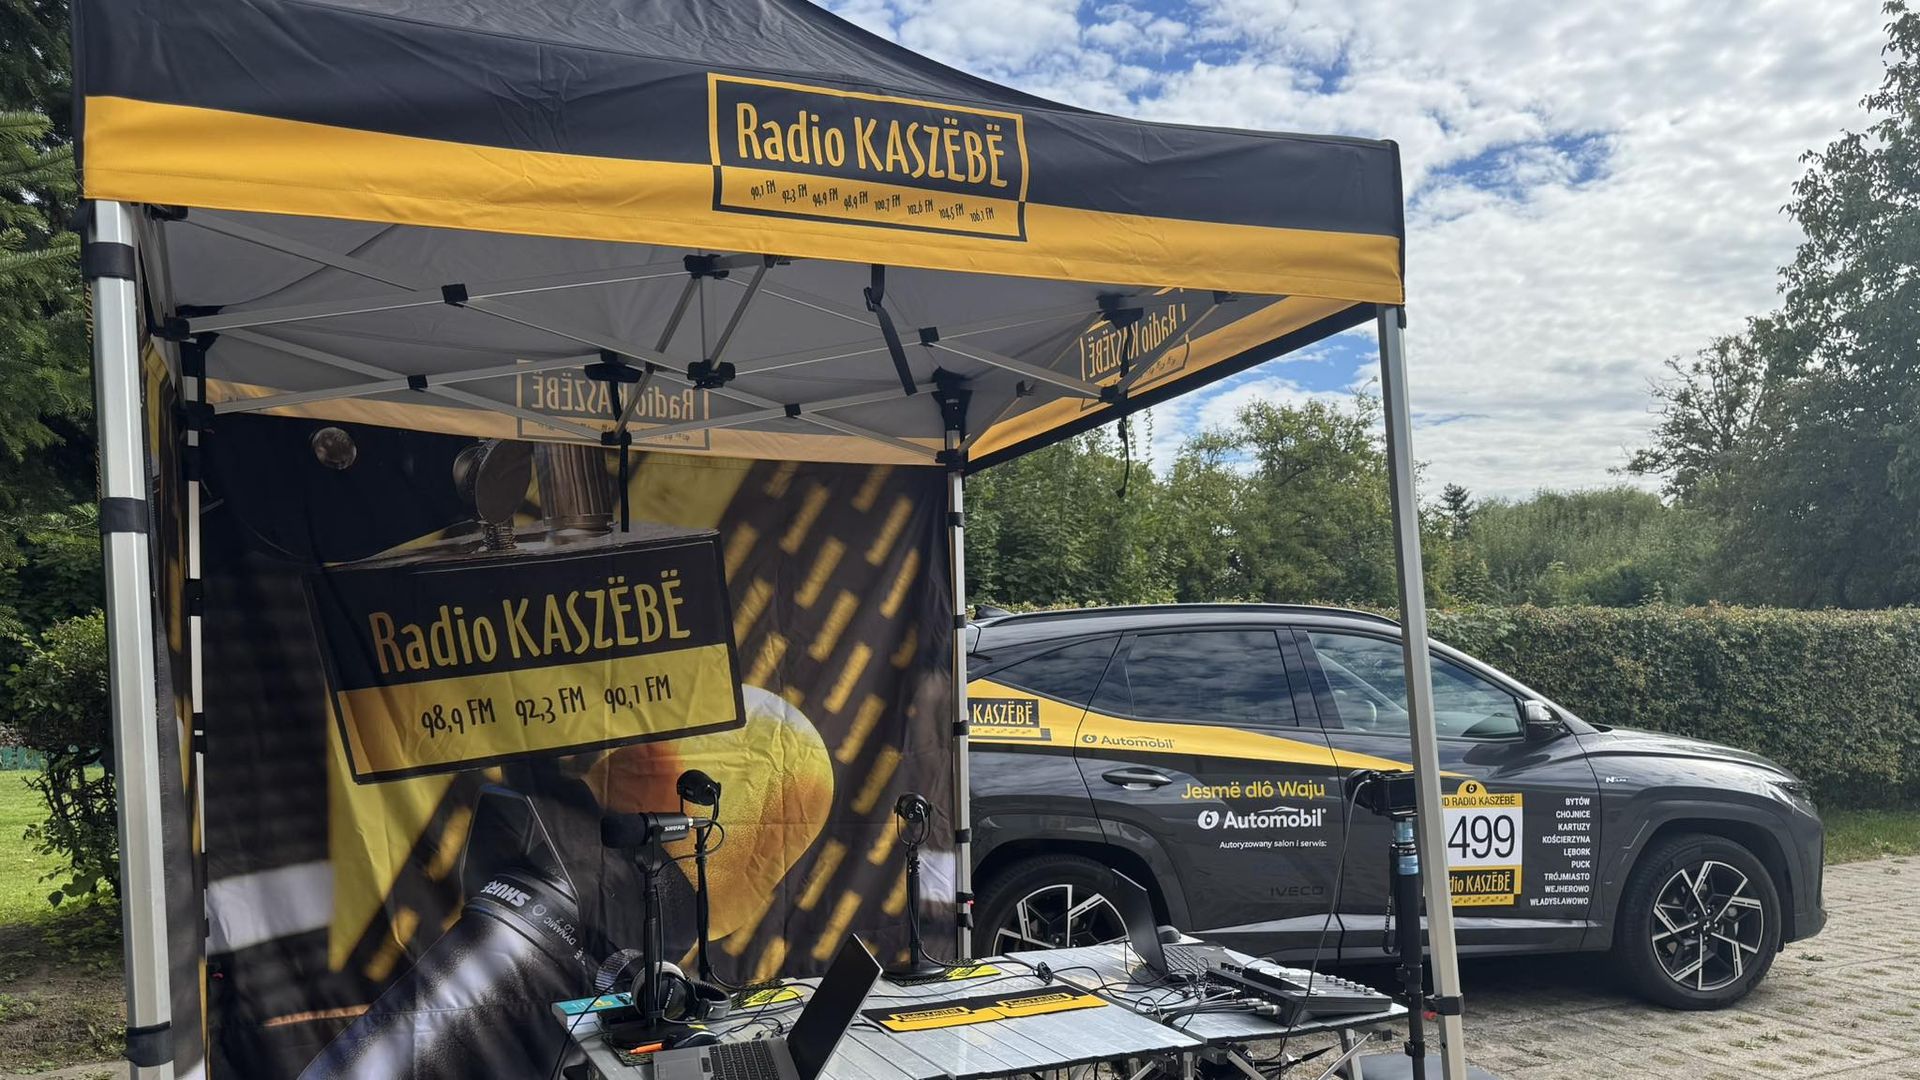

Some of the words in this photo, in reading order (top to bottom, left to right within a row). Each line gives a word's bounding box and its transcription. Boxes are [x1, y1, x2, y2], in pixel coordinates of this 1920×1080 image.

[736, 103, 845, 167] Radio
[854, 116, 1008, 188] KASZËBË
[766, 180, 776, 194] FM
[798, 184, 807, 198] FM
[829, 187, 838, 201] FM
[859, 191, 868, 204] FM
[892, 194, 900, 207] FM
[924, 199, 934, 213] FM
[955, 203, 964, 216] FM
[985, 207, 994, 220] FM
[368, 605, 497, 674] Radio
[503, 569, 691, 659] KASZËBË
[421, 704, 465, 738] 98,9
[469, 697, 496, 726] FM
[515, 696, 556, 726] 92,3
[559, 686, 586, 714] FM
[604, 684, 640, 714] 90,1
[645, 674, 672, 703] FM
[973, 701, 1034, 726] KASZËBË
[1101, 735, 1173, 749] Automobil
[1181, 782, 1241, 800] Jesmë
[1245, 781, 1274, 798] dlô
[1278, 780, 1325, 800] Waju
[1452, 797, 1477, 806] RADIO
[1565, 796, 1590, 805] BYTÓW
[1223, 807, 1322, 829] Automobil
[1556, 810, 1590, 818] CHOJNICE
[1558, 823, 1590, 831] KARTUZY
[1447, 815, 1515, 858] 499
[1542, 835, 1590, 844] KOŚCIERZYNA
[1219, 840, 1273, 850] Autoryzowany
[1571, 860, 1590, 868] PUCK
[1449, 876, 1464, 892] dio
[1466, 871, 1510, 892] KASZËBË
[1544, 872, 1589, 880] TRÓJMIASTO
[1270, 886, 1324, 897] IVECO
[1530, 897, 1588, 906] WŁADYSŁAWOWO
[543, 917, 576, 945] DYNAMIC
